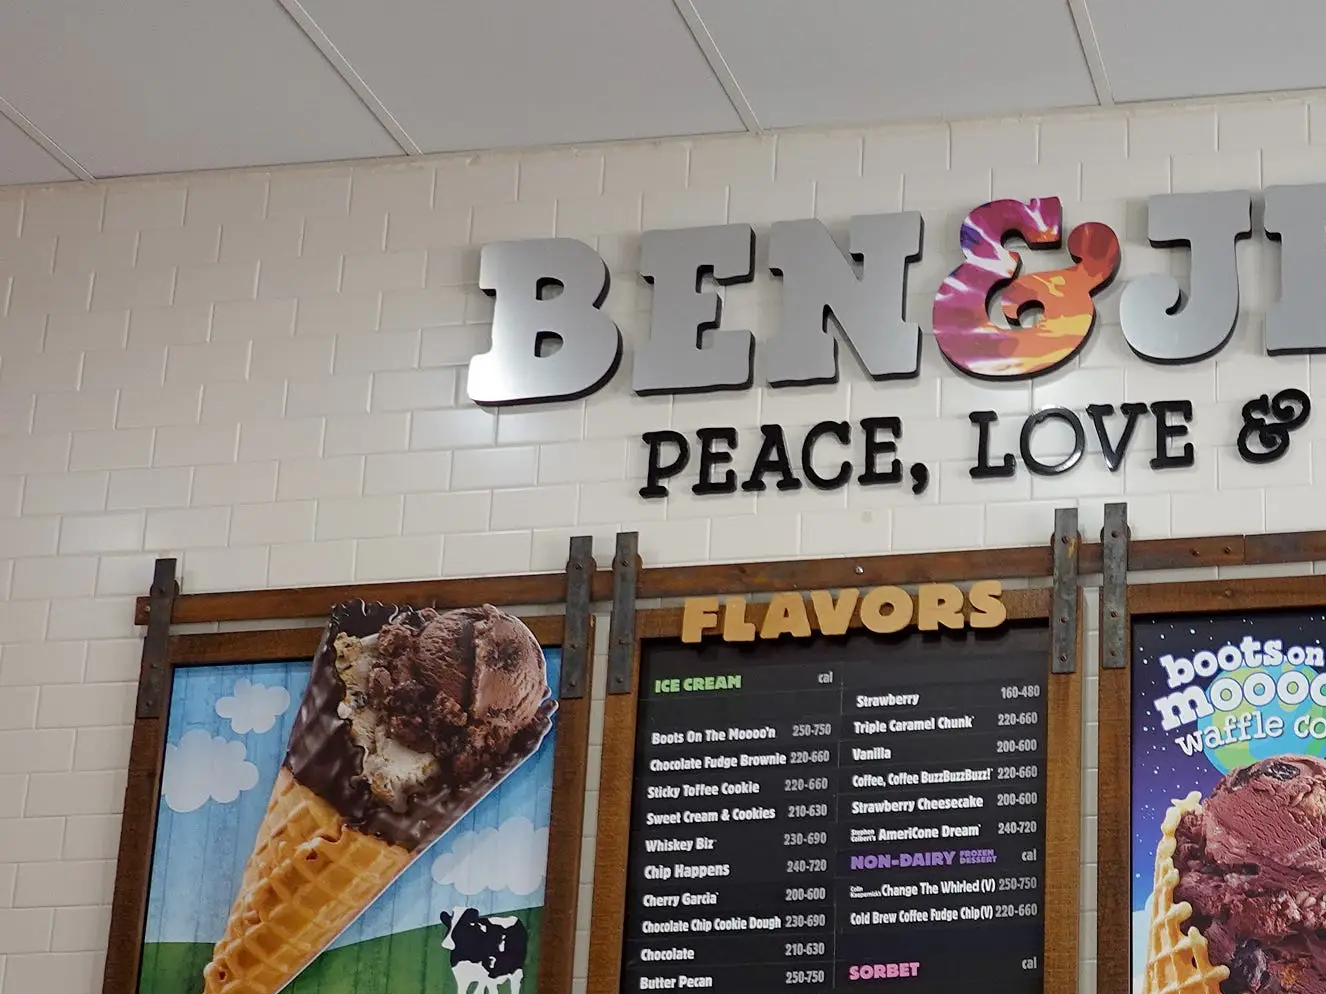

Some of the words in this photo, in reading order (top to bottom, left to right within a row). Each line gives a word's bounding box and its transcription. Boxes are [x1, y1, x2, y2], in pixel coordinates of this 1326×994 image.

[638, 414, 930, 499] PEACE,
[967, 398, 1194, 477] LOVE
[1236, 387, 1312, 464] &
[681, 581, 1006, 644] FLAVORS
[1159, 636, 1286, 688] boots
[1288, 650, 1324, 667] on
[655, 679, 680, 693] ICE
[683, 675, 741, 691] CREAM
[818, 671, 833, 683] cal
[857, 694, 919, 707] Strawberry
[1001, 685, 1040, 699] 160-480
[652, 732, 684, 744] Boots
[687, 731, 702, 742] On
[705, 729, 726, 741] The
[729, 727, 775, 740] Moooo'n
[793, 724, 831, 736] 250-750
[1176, 712, 1285, 757] waffle
[852, 747, 891, 760] Vanilla
[997, 739, 1037, 752] 200-600
[650, 758, 702, 771] Chocolate
[704, 756, 737, 768] Fudge
[740, 753, 786, 766] Brownie
[790, 750, 829, 763] 220-660
[647, 812, 681, 825] Sweet
[683, 811, 718, 823] Cream
[721, 809, 730, 821] &
[732, 807, 775, 820] Cookies
[788, 804, 827, 817] 210-630
[644, 865, 671, 880] Chip
[674, 864, 729, 878] Happens
[787, 859, 826, 872] 240-720
[851, 851, 956, 869] NON-DAIRY
[960, 856, 997, 864] DESSERT
[1022, 849, 1036, 861] cal
[642, 920, 689, 933] Chocolate
[691, 919, 712, 932] Chip
[714, 917, 747, 930] Cookie
[749, 916, 781, 929] Dough
[785, 914, 825, 927] 230-690
[850, 962, 919, 980] SORBET
[1022, 957, 1036, 969] cal
[640, 977, 676, 989] Butter
[679, 976, 712, 988] Pecan
[786, 970, 824, 983] 250-750
